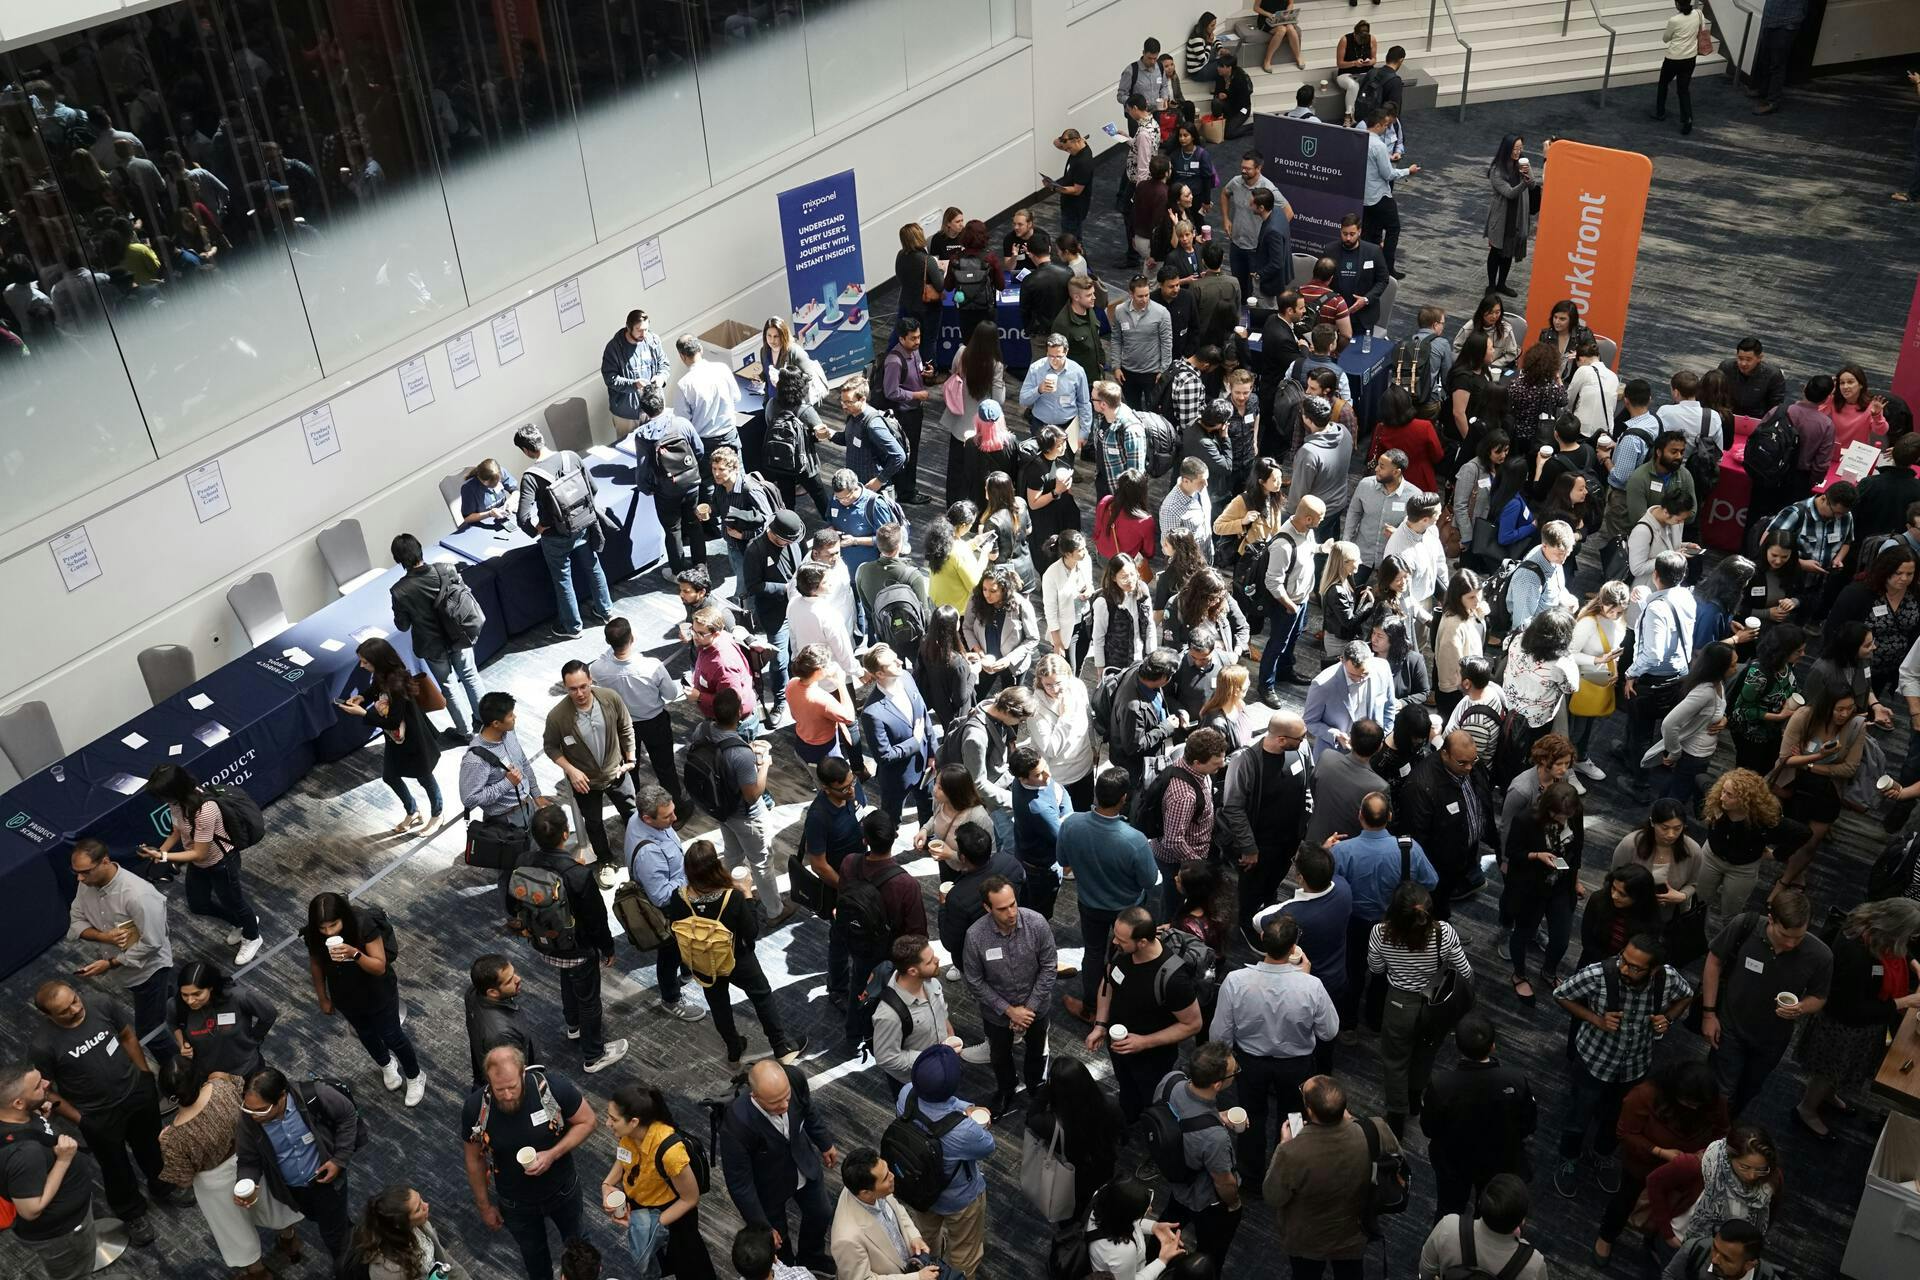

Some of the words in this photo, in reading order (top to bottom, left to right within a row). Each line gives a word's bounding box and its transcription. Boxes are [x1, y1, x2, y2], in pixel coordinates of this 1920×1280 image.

[1274, 157, 1310, 170] PRODUCT
[1311, 165, 1343, 176] SCHOOL
[1286, 169, 1308, 177] SILICON
[802, 190, 837, 209] mixpanel
[798, 214, 845, 235] UNDERSTAND
[1298, 214, 1323, 225] Product
[1322, 219, 1343, 229] Mana
[800, 233, 822, 247] EVERY
[822, 225, 847, 239] USER'S
[799, 241, 832, 259] JOURNEY
[831, 235, 850, 247] WITH
[795, 256, 824, 272] INSTANT
[824, 244, 857, 261] INSIGHTS
[1565, 192, 1607, 326] orkfront
[310, 425, 330, 438] Product
[197, 482, 218, 496] Product
[200, 488, 219, 500] School
[63, 548, 87, 564] Product
[67, 554, 88, 568] School
[70, 561, 89, 573] Guest
[201, 748, 256, 788] RODUCT
[20, 827, 44, 843] SCHOOL
[28, 821, 56, 840] PRODUCT
